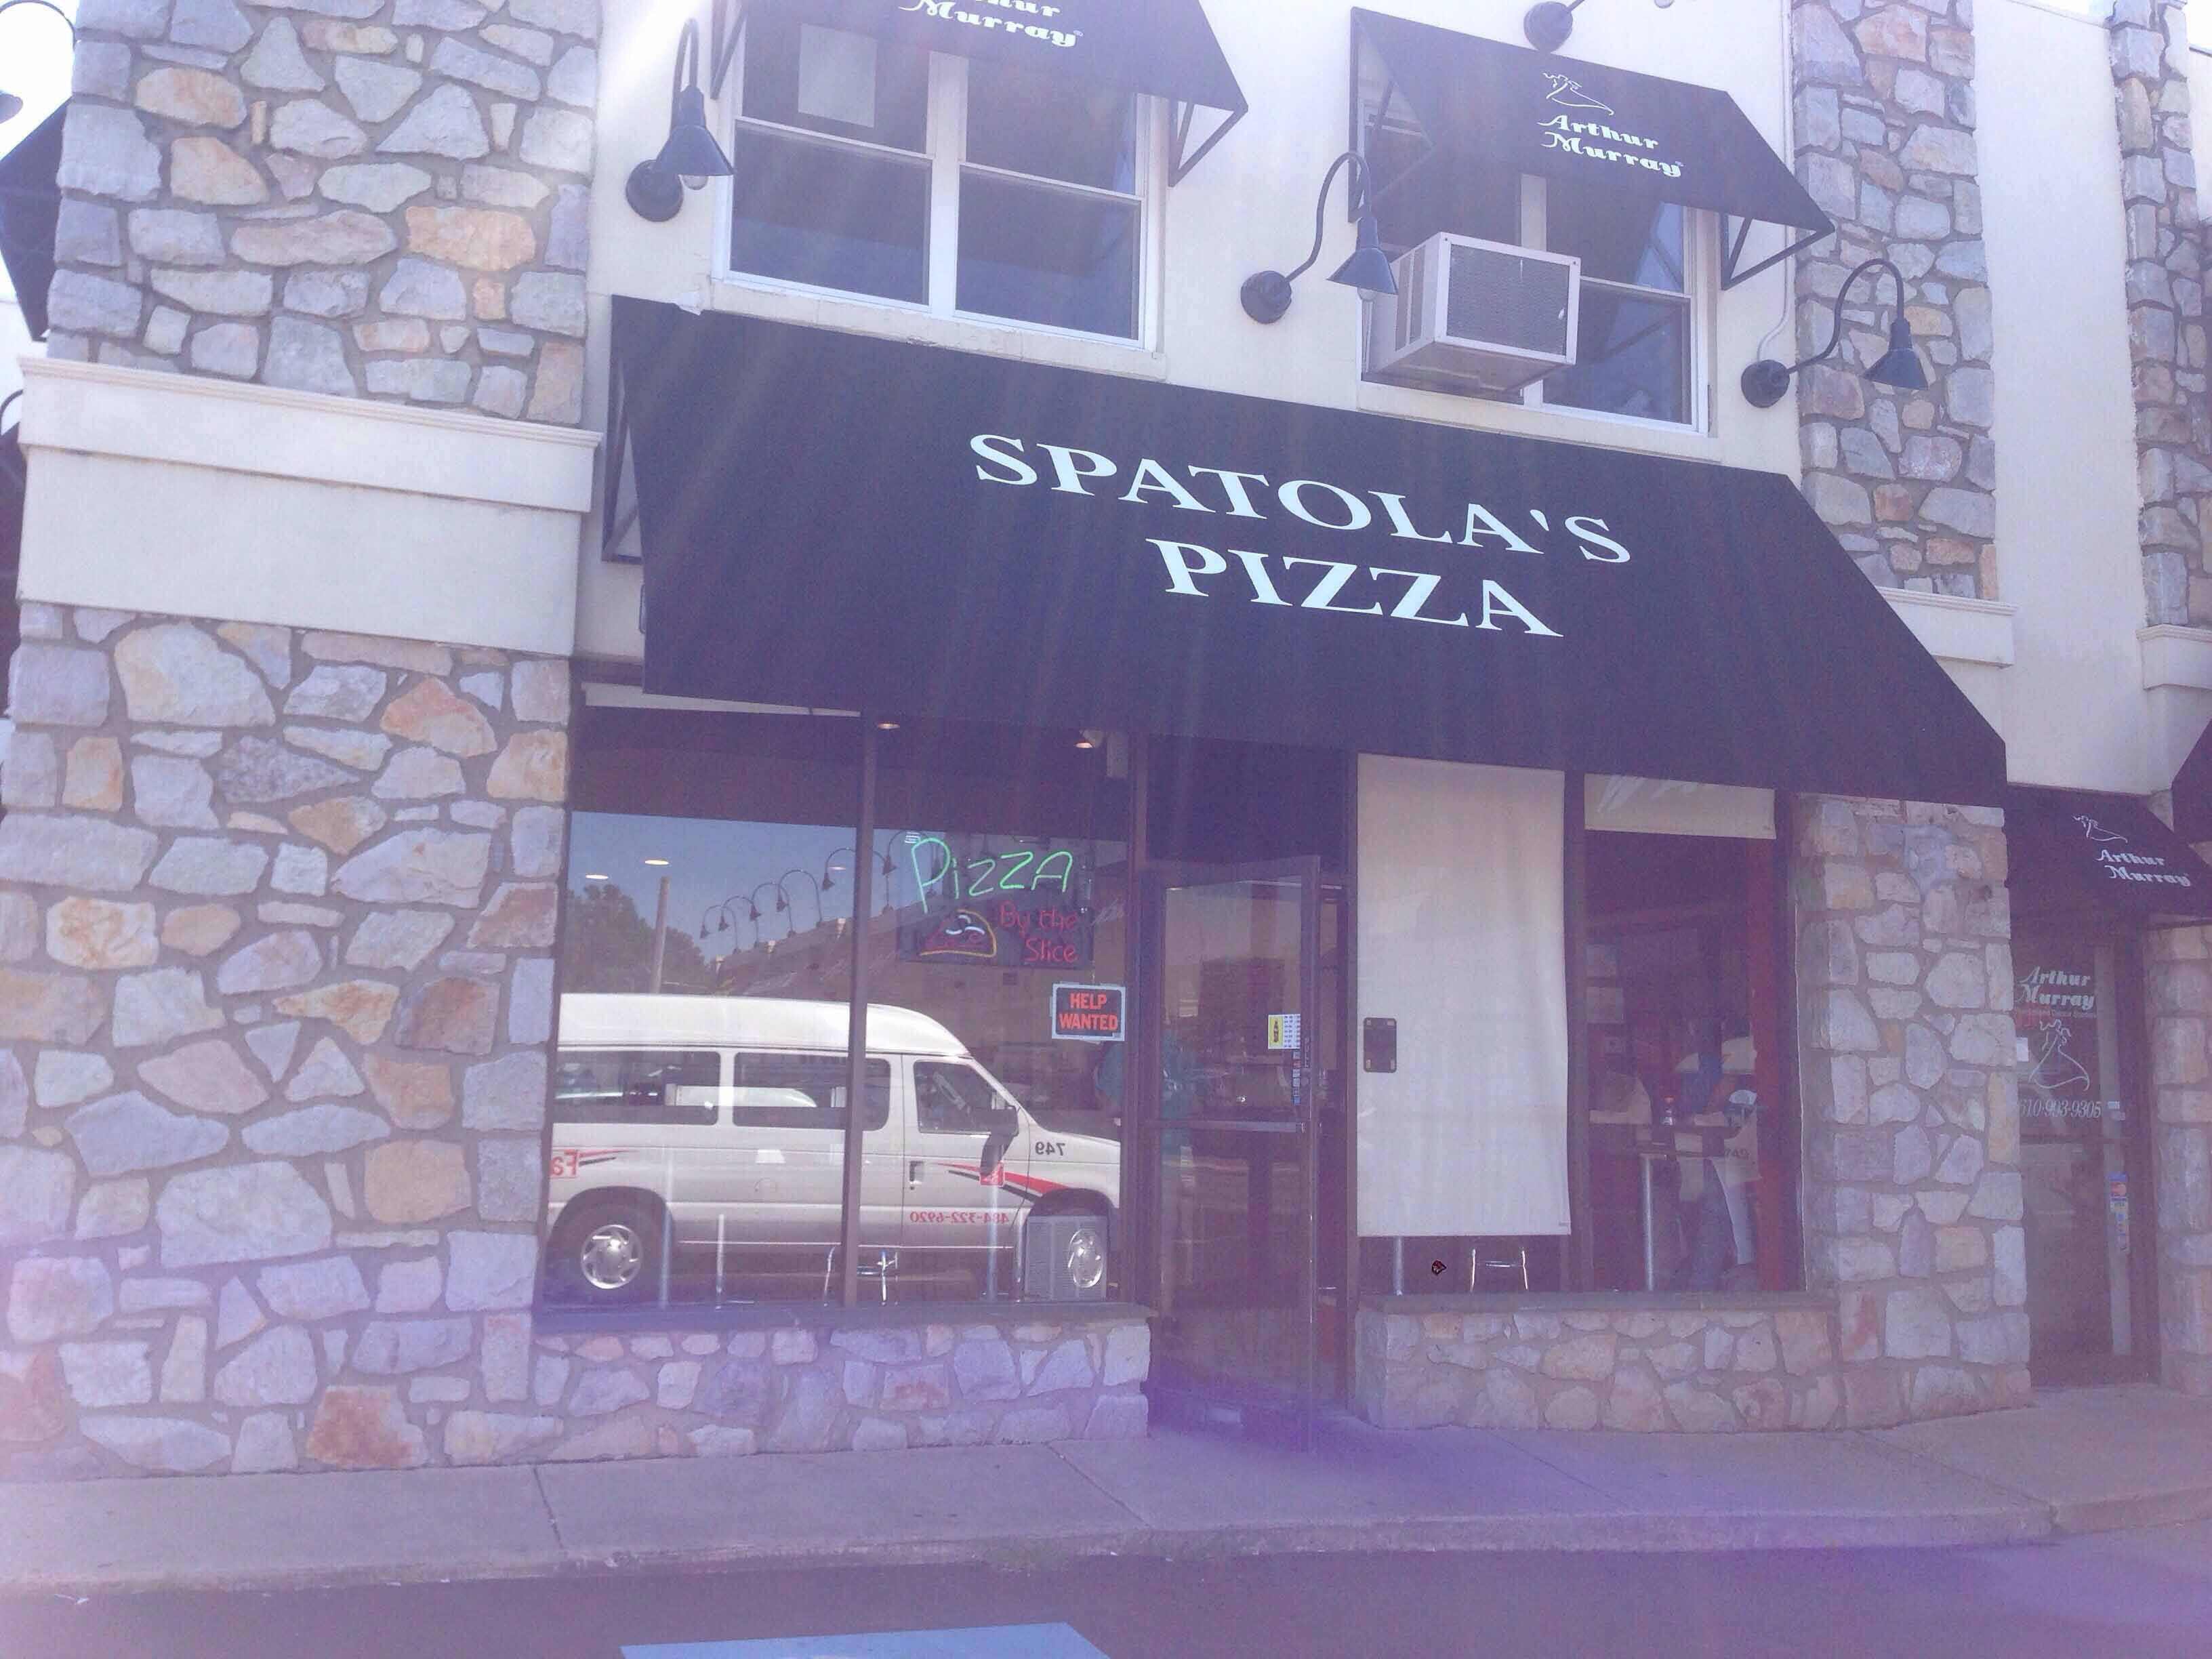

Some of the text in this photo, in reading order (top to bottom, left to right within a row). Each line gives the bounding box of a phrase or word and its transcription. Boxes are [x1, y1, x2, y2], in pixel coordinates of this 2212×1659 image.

[898, 0, 1076, 47] Murray
[1537, 115, 1658, 149] Arthur
[1540, 131, 1681, 178] Murray
[969, 434, 1631, 564] SPATOLA'S
[1145, 537, 1564, 637] PIZZA
[2095, 849, 2166, 866] Arthur
[2104, 865, 2191, 887] Murray
[1000, 901, 1079, 937] By the
[1023, 937, 1078, 963] Slice
[2019, 965, 2091, 986] Arthur
[1069, 992, 1107, 1009] HELP
[2015, 983, 2095, 1010] Murray
[1059, 1013, 1118, 1031] WANTED
